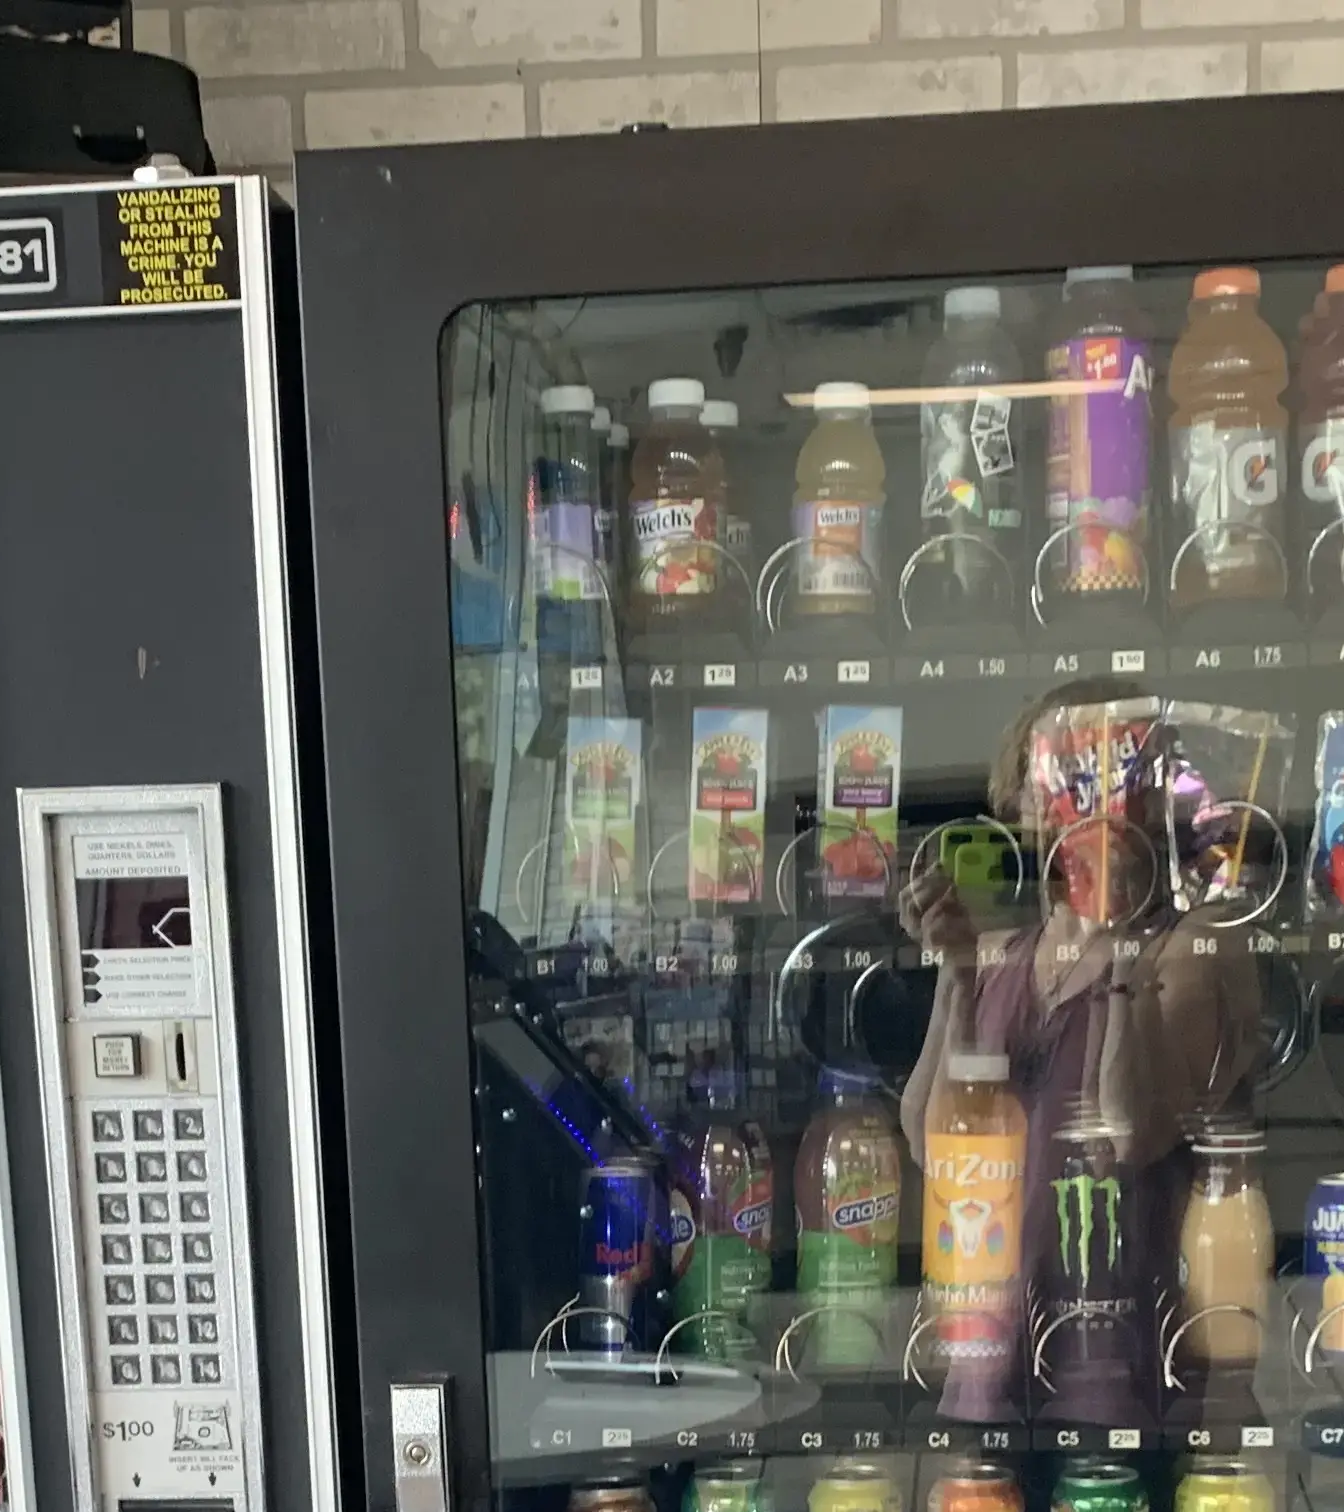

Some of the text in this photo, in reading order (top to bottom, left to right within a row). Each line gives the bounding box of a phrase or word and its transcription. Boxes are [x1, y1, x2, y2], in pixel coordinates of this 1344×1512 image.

[117, 187, 220, 206] VANDALIZING
[119, 203, 220, 222] OR STEALING
[130, 220, 211, 239] FROM THIS
[120, 236, 223, 256] MACHINE IS A
[128, 253, 216, 270] CRIME. YOU
[143, 270, 204, 286] WILL BE
[1230, 439, 1277, 506] G
[634, 504, 694, 536] Welch's
[1055, 655, 1078, 672] A5
[1196, 647, 1282, 668] A6 1.75
[650, 669, 673, 685] A2
[784, 665, 808, 681] A3
[920, 659, 1005, 678] A4 1.50
[85, 866, 181, 876] AMOUNT DEPOSITED
[1056, 940, 1139, 962] B5 1.00
[1193, 936, 1274, 954] B6 1.00
[656, 956, 737, 972] B2 1.00
[844, 953, 870, 967] 1.00
[921, 950, 1005, 966] B4 1.00
[103, 1421, 154, 1441] $1.00
[677, 1431, 755, 1448] C2 1.75
[1057, 1430, 1079, 1446] C5
[1188, 1430, 1210, 1446] C6
[1321, 1428, 1344, 1444] C7
[801, 1433, 879, 1448] C3 1.75
[928, 1432, 1008, 1448] C4 1.75
